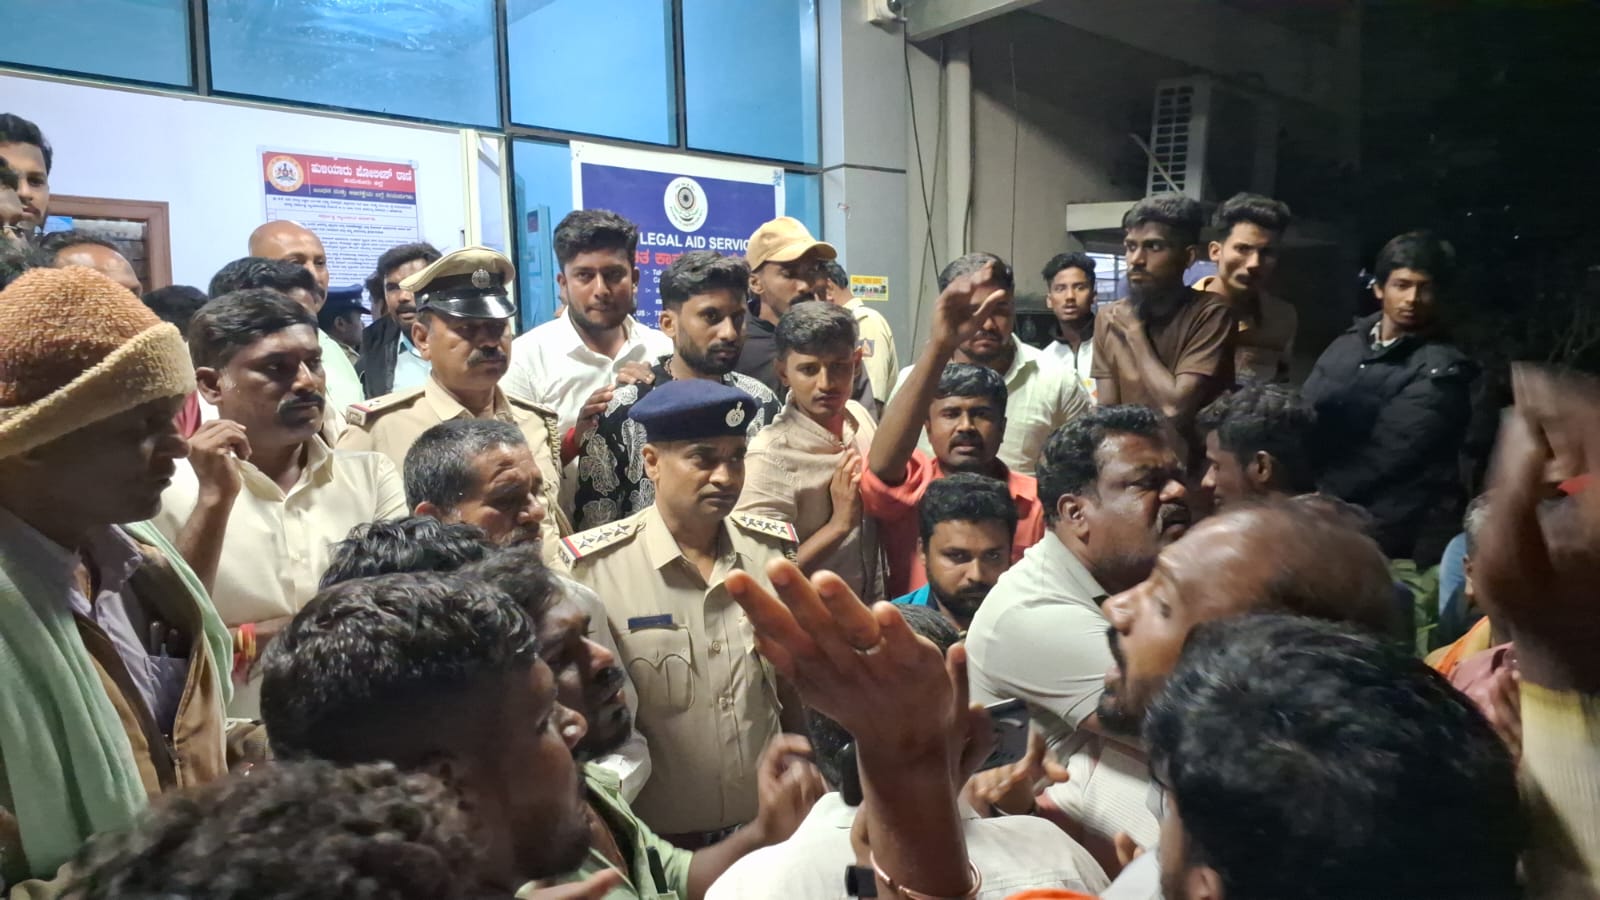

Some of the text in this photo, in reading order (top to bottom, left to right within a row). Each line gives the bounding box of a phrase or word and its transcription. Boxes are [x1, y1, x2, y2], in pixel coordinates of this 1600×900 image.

[640, 232, 749, 251] LEGAL AID SERVIC
